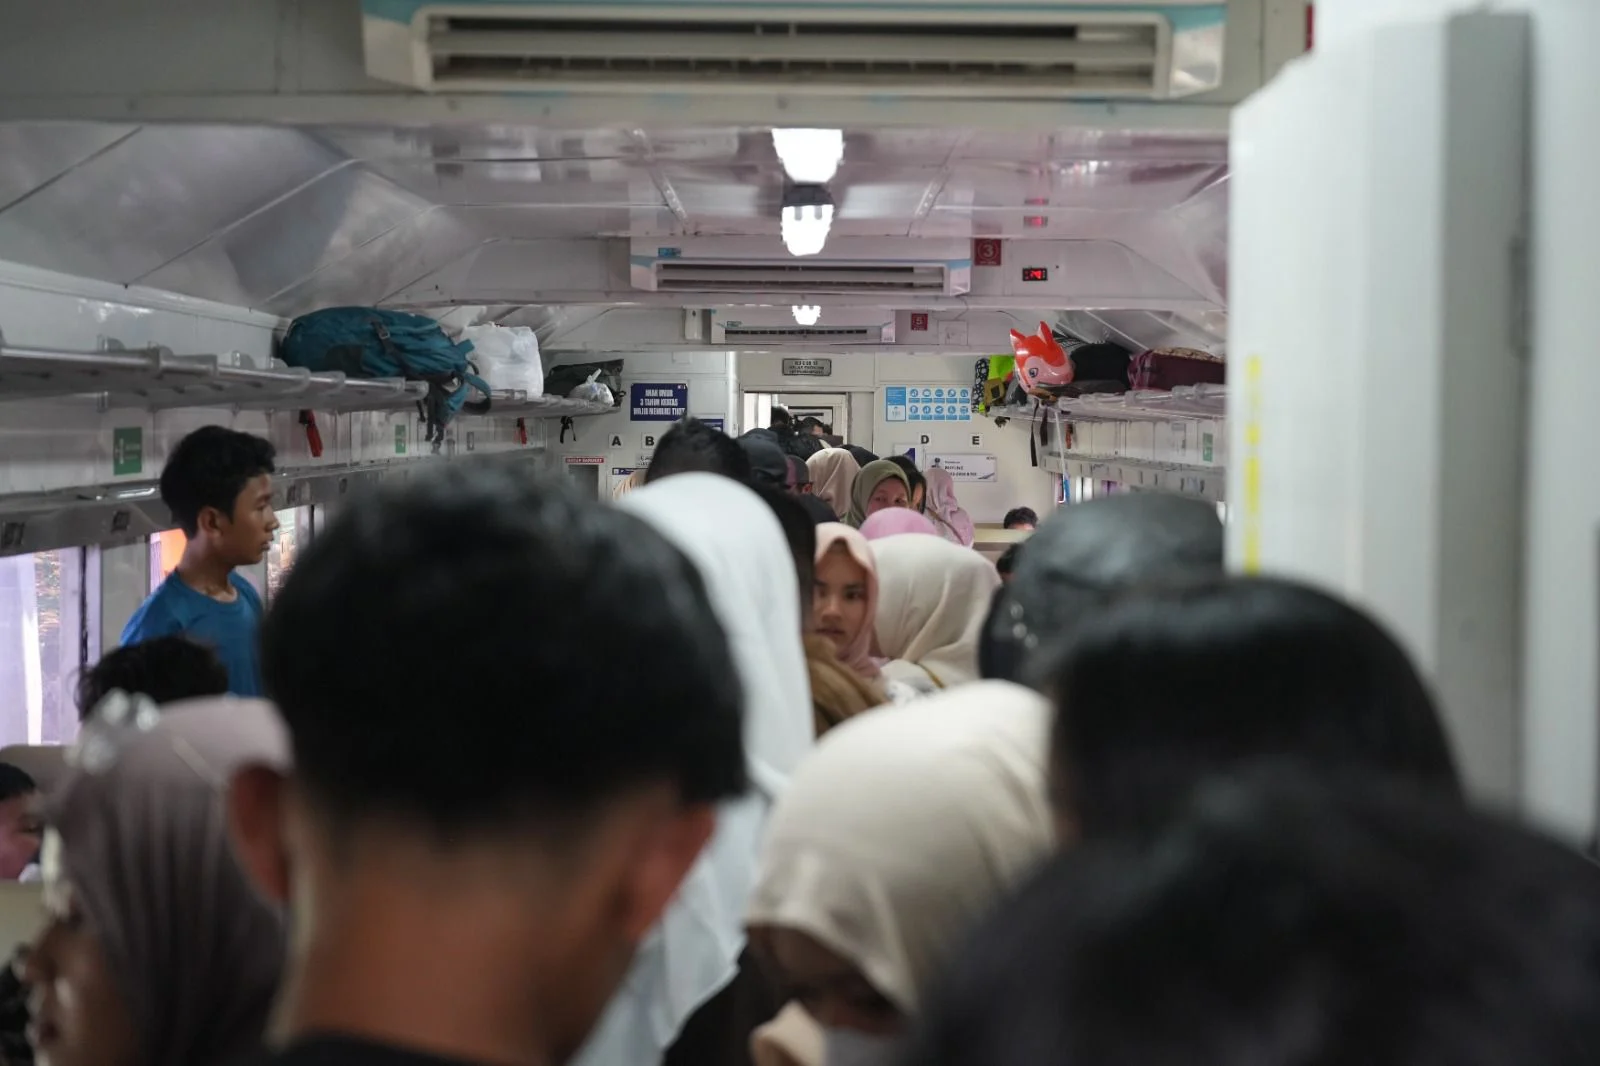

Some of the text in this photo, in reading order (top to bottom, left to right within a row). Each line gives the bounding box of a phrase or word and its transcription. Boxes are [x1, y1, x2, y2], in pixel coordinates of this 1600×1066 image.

[983, 244, 994, 258] 3
[611, 436, 622, 446] A
[645, 436, 655, 446] B
[921, 435, 930, 444] D
[972, 436, 980, 445] E
